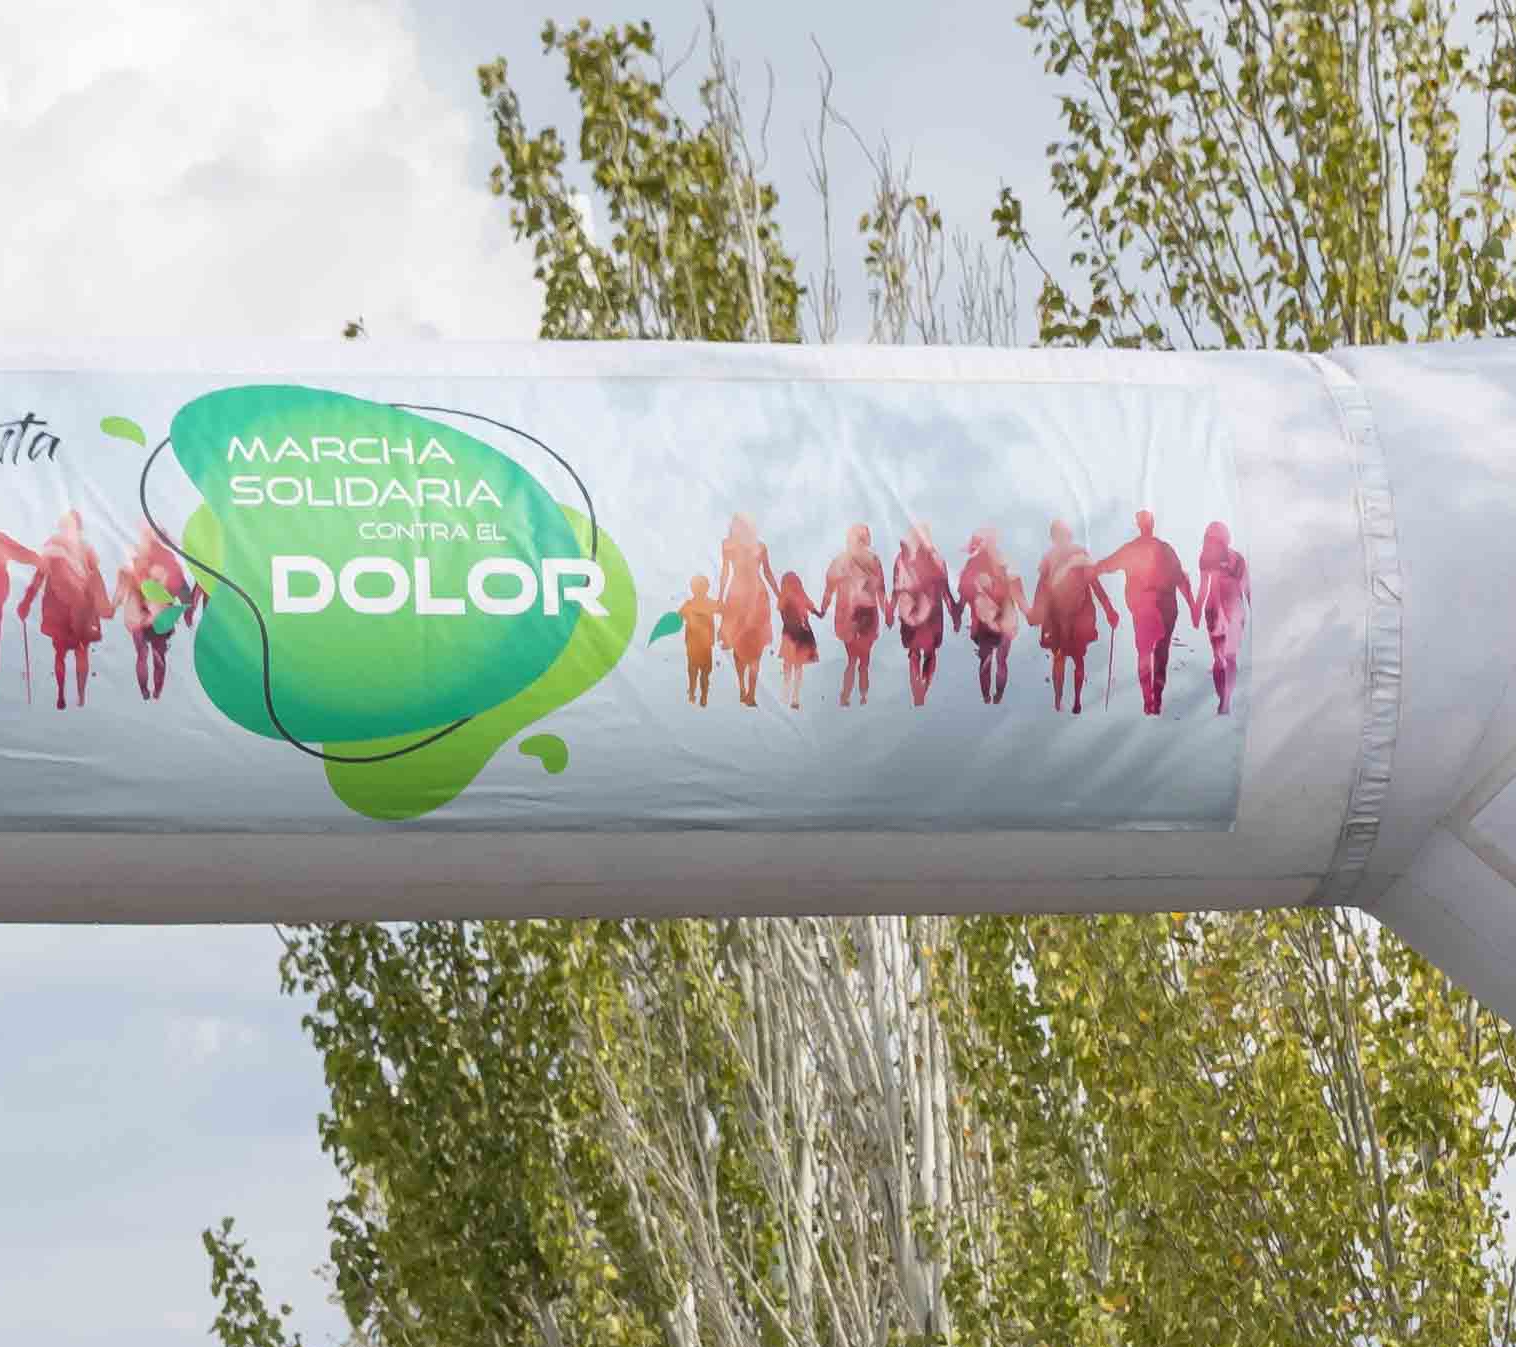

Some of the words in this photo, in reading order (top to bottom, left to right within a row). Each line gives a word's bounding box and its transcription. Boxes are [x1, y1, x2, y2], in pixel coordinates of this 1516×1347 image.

[227, 435, 455, 465] MARCHA
[229, 475, 504, 509] SOLIDARIA
[358, 522, 469, 542] CONTRA
[476, 524, 507, 542] EL
[270, 554, 610, 618] DOLOR
